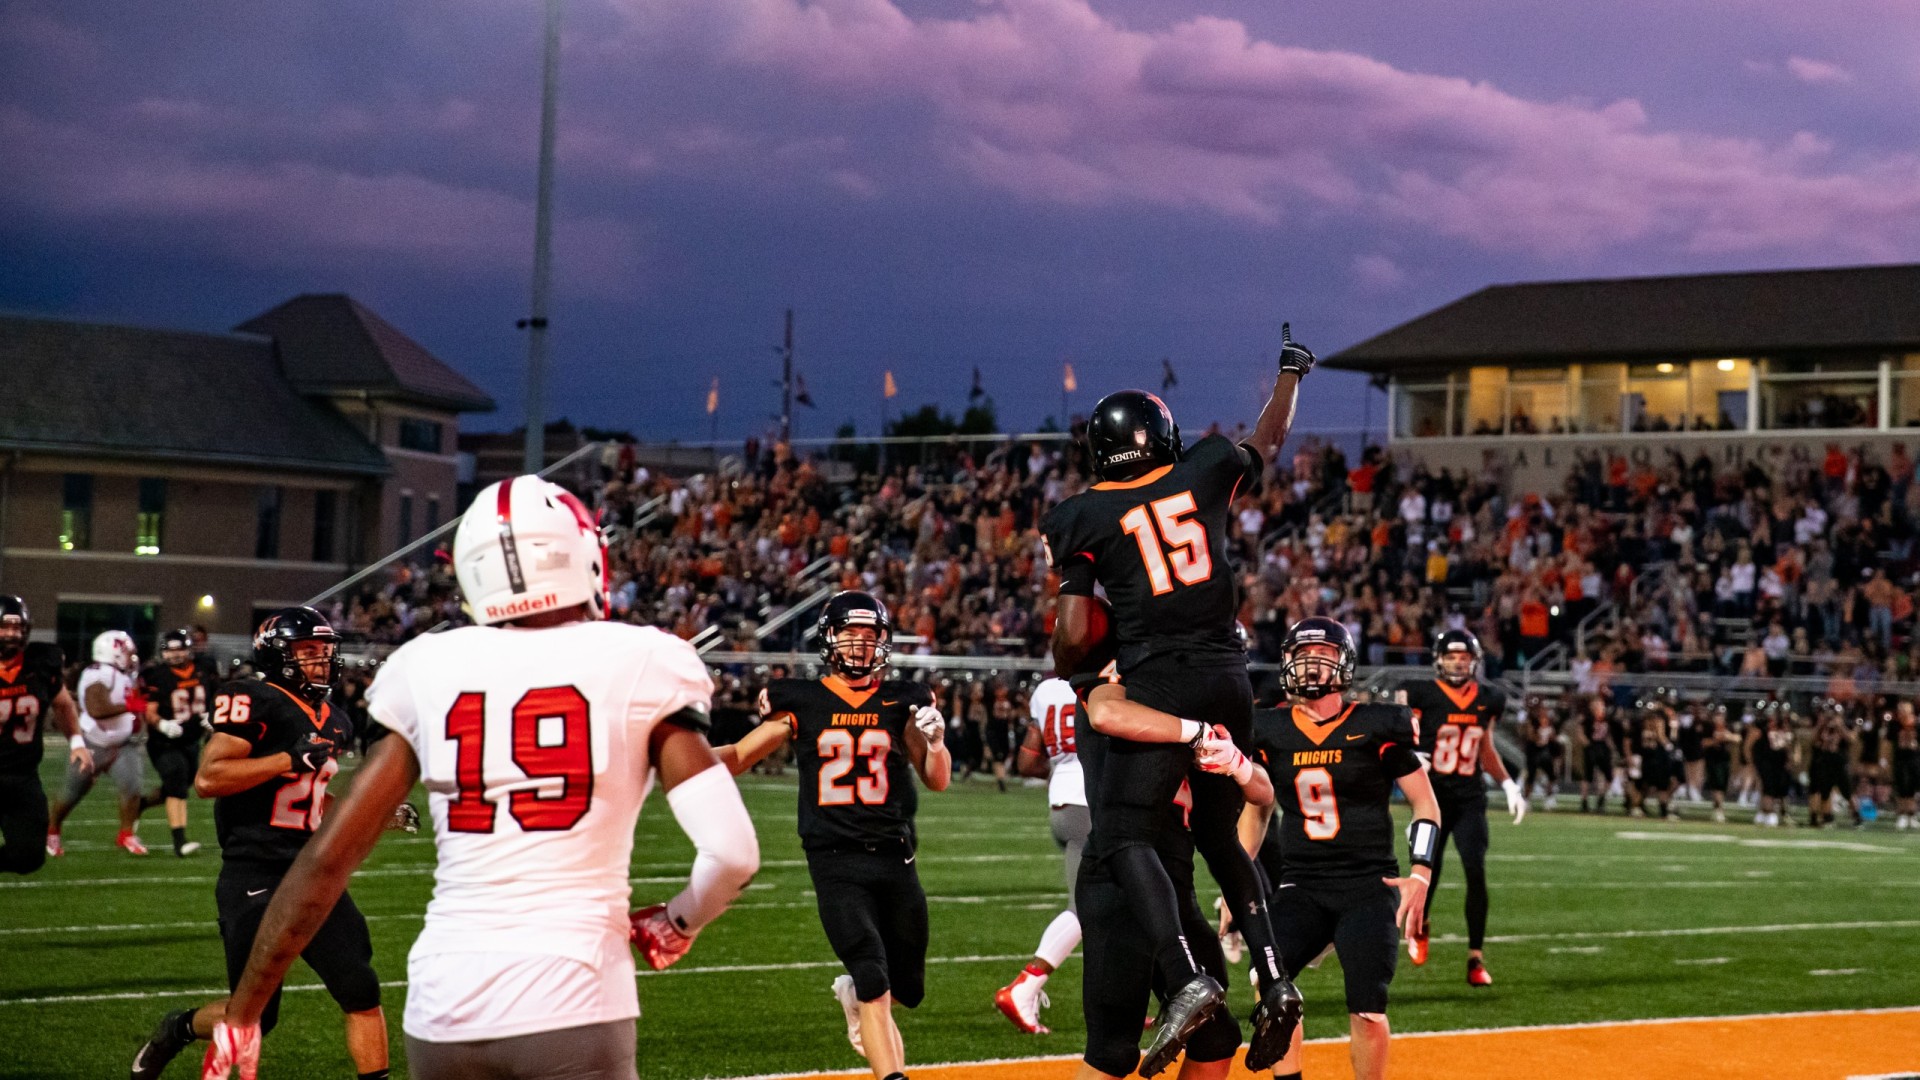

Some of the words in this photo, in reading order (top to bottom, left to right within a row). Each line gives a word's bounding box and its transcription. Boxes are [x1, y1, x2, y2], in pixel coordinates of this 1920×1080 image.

[1108, 449, 1142, 464] XENITH
[1119, 490, 1213, 597] 15
[486, 593, 558, 618] Riddell
[213, 693, 252, 724] 26
[831, 713, 880, 726] KNIGHTS
[445, 684, 594, 834] 19
[816, 728, 892, 806] 23
[1292, 749, 1343, 766] KNIGHTS
[1433, 723, 1484, 776] 89
[1294, 767, 1341, 841] 9
